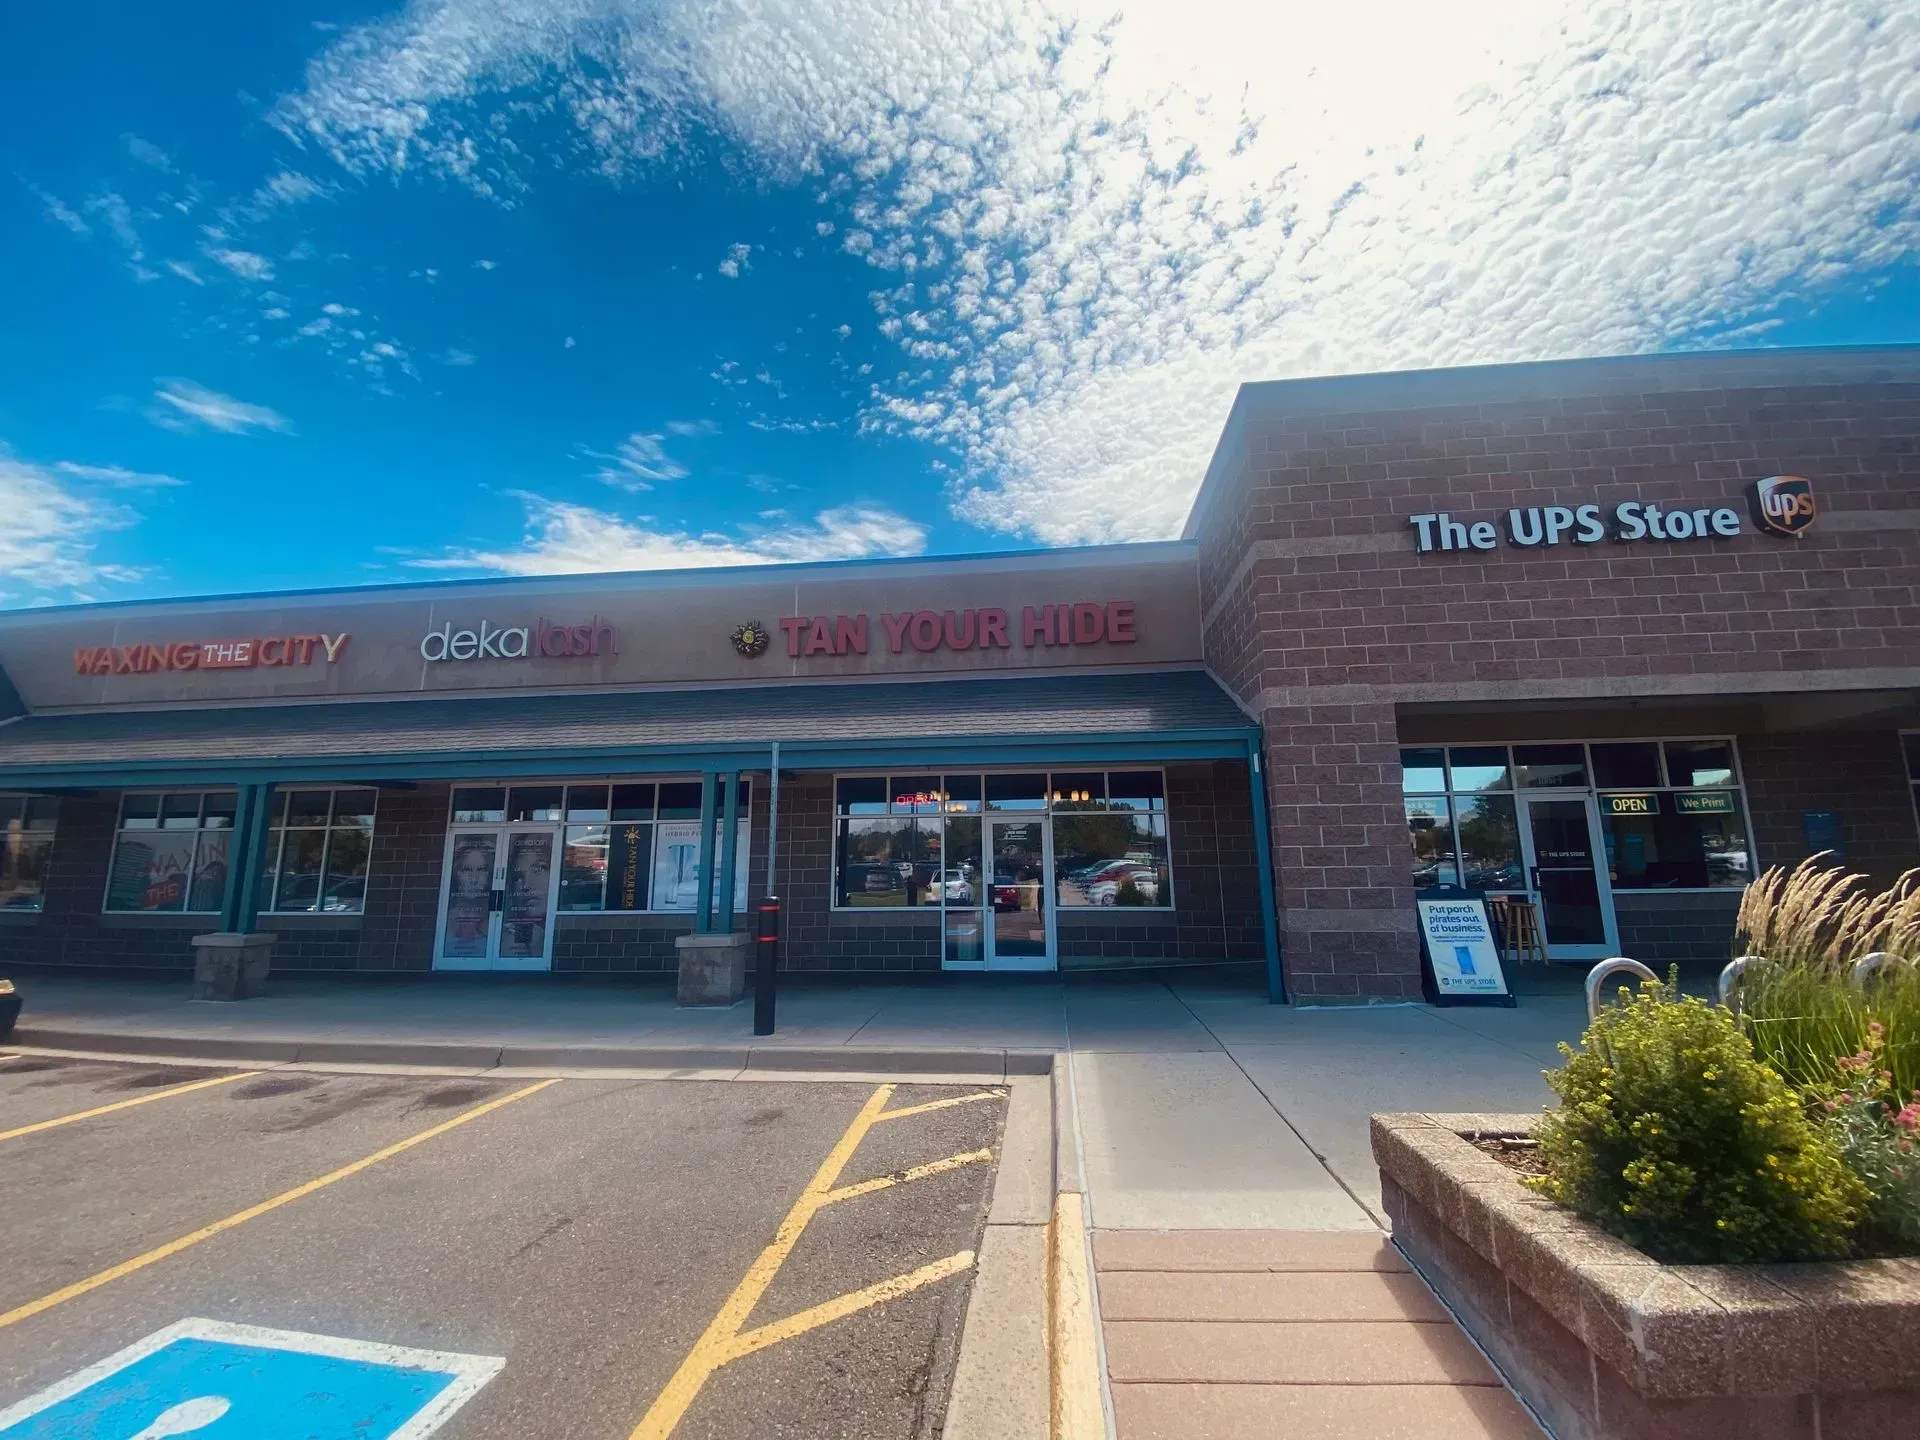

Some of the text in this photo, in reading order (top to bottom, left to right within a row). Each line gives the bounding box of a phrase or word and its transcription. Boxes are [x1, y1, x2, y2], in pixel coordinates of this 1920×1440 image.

[1763, 491, 1813, 525] ups
[1409, 501, 1741, 551] The UPS Store
[420, 613, 619, 661] deka lash
[779, 601, 1136, 657] TAN YOUR HIDE
[74, 631, 348, 675] WAXING THE CITY
[896, 795, 932, 806] OPEN
[1612, 798, 1648, 811] OPEN
[1681, 797, 1726, 809] We Print
[145, 840, 228, 875] WAXIN
[628, 846, 638, 864] TAN
[626, 864, 637, 888] YOUR
[146, 882, 179, 899] THE
[625, 889, 635, 909] HIDE
[1429, 905, 1474, 915] Put porch
[1430, 915, 1480, 925] pirates out
[1430, 924, 1486, 933] of business.
